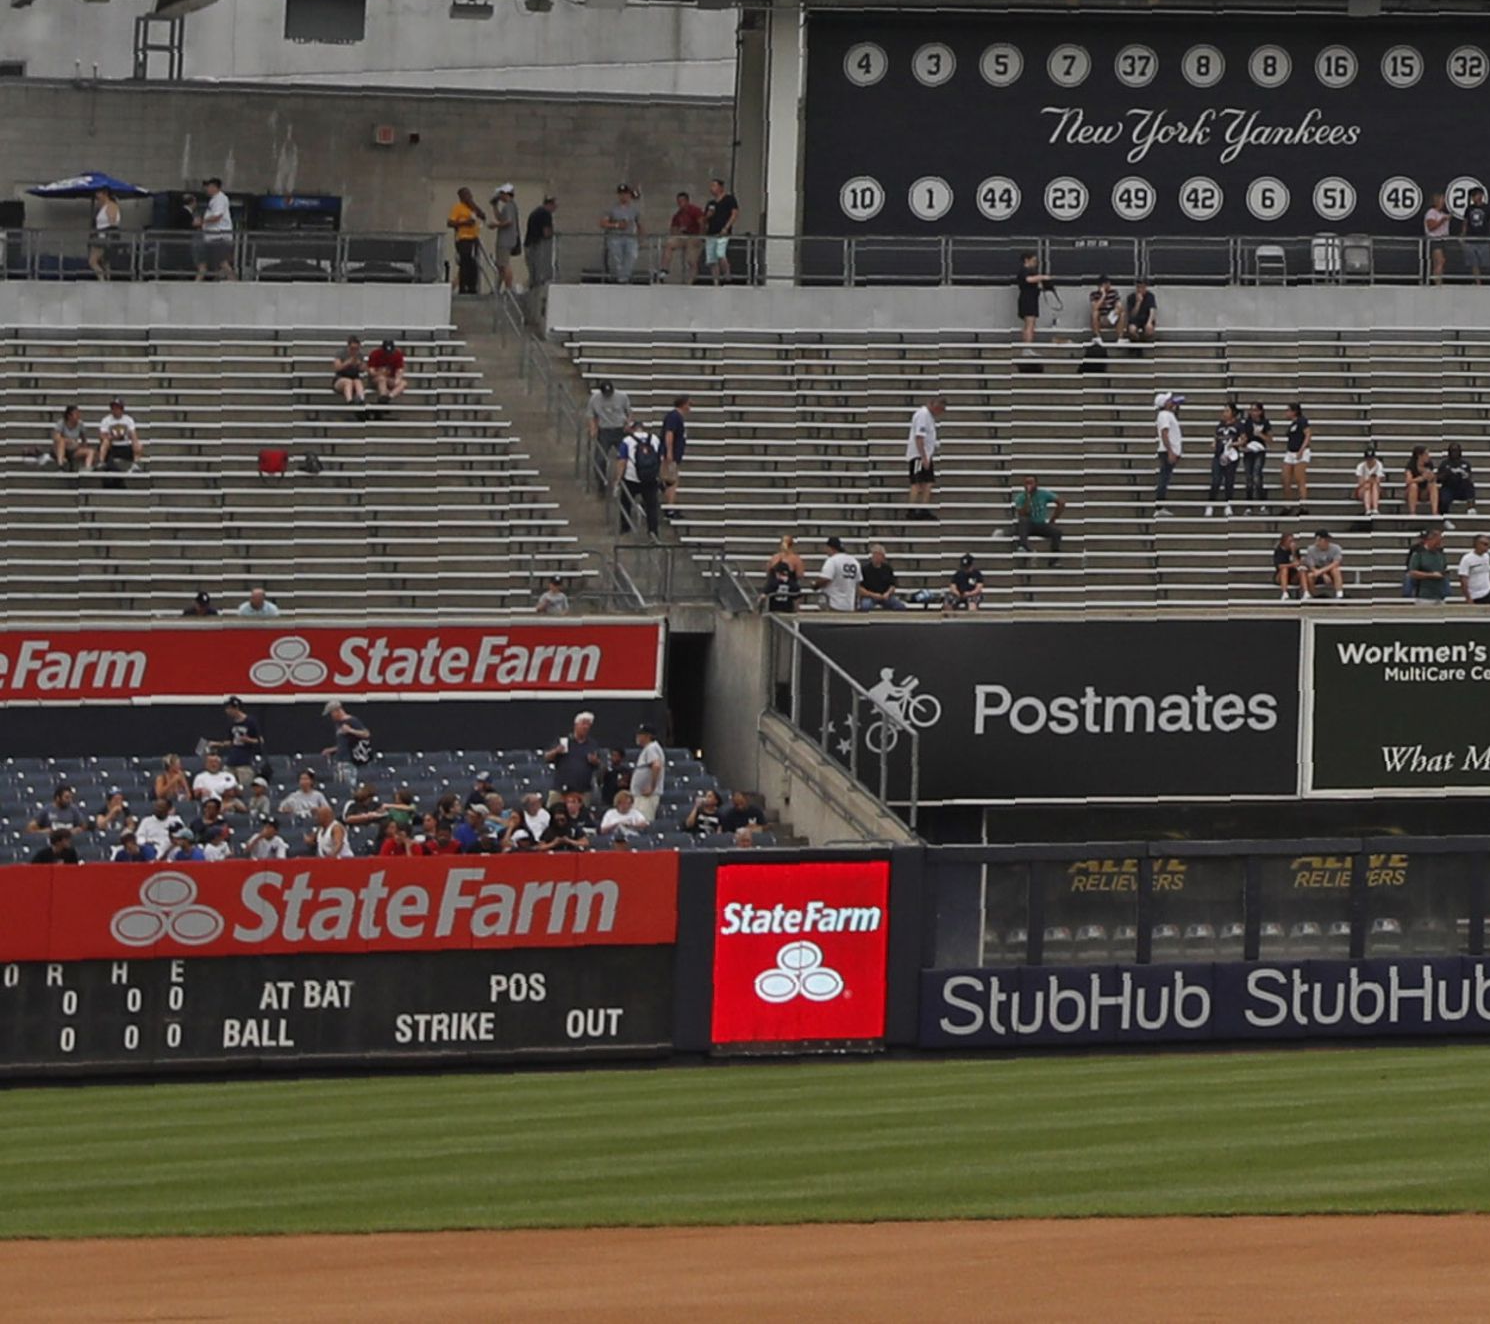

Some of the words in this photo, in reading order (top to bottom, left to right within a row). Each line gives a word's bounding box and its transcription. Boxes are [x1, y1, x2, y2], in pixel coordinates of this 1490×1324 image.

[857, 53, 871, 74] 4
[928, 53, 941, 75] 3
[995, 54, 1008, 75] 5
[1062, 55, 1076, 75] 7
[1123, 55, 1151, 76] 37
[1197, 55, 1210, 76] 8
[1264, 56, 1276, 76] 8
[1325, 56, 1348, 77] 16
[1391, 56, 1414, 76] 15
[1455, 56, 1482, 77] 32
[1042, 107, 1123, 143] New
[1126, 108, 1215, 164] York
[1219, 108, 1361, 164] Yankees
[1338, 641, 1486, 664] Workmen's
[1385, 667, 1465, 681] MultiCare
[975, 685, 1276, 734] Postmates
[1382, 745, 1454, 771] What
[260, 982, 294, 1009] AT
[304, 981, 353, 1007] BAT
[491, 973, 545, 1002] POS
[941, 971, 1210, 1034] StubHub
[224, 1019, 294, 1047] BALL
[396, 1013, 494, 1042] STRIKE
[567, 1009, 623, 1037] OUT
